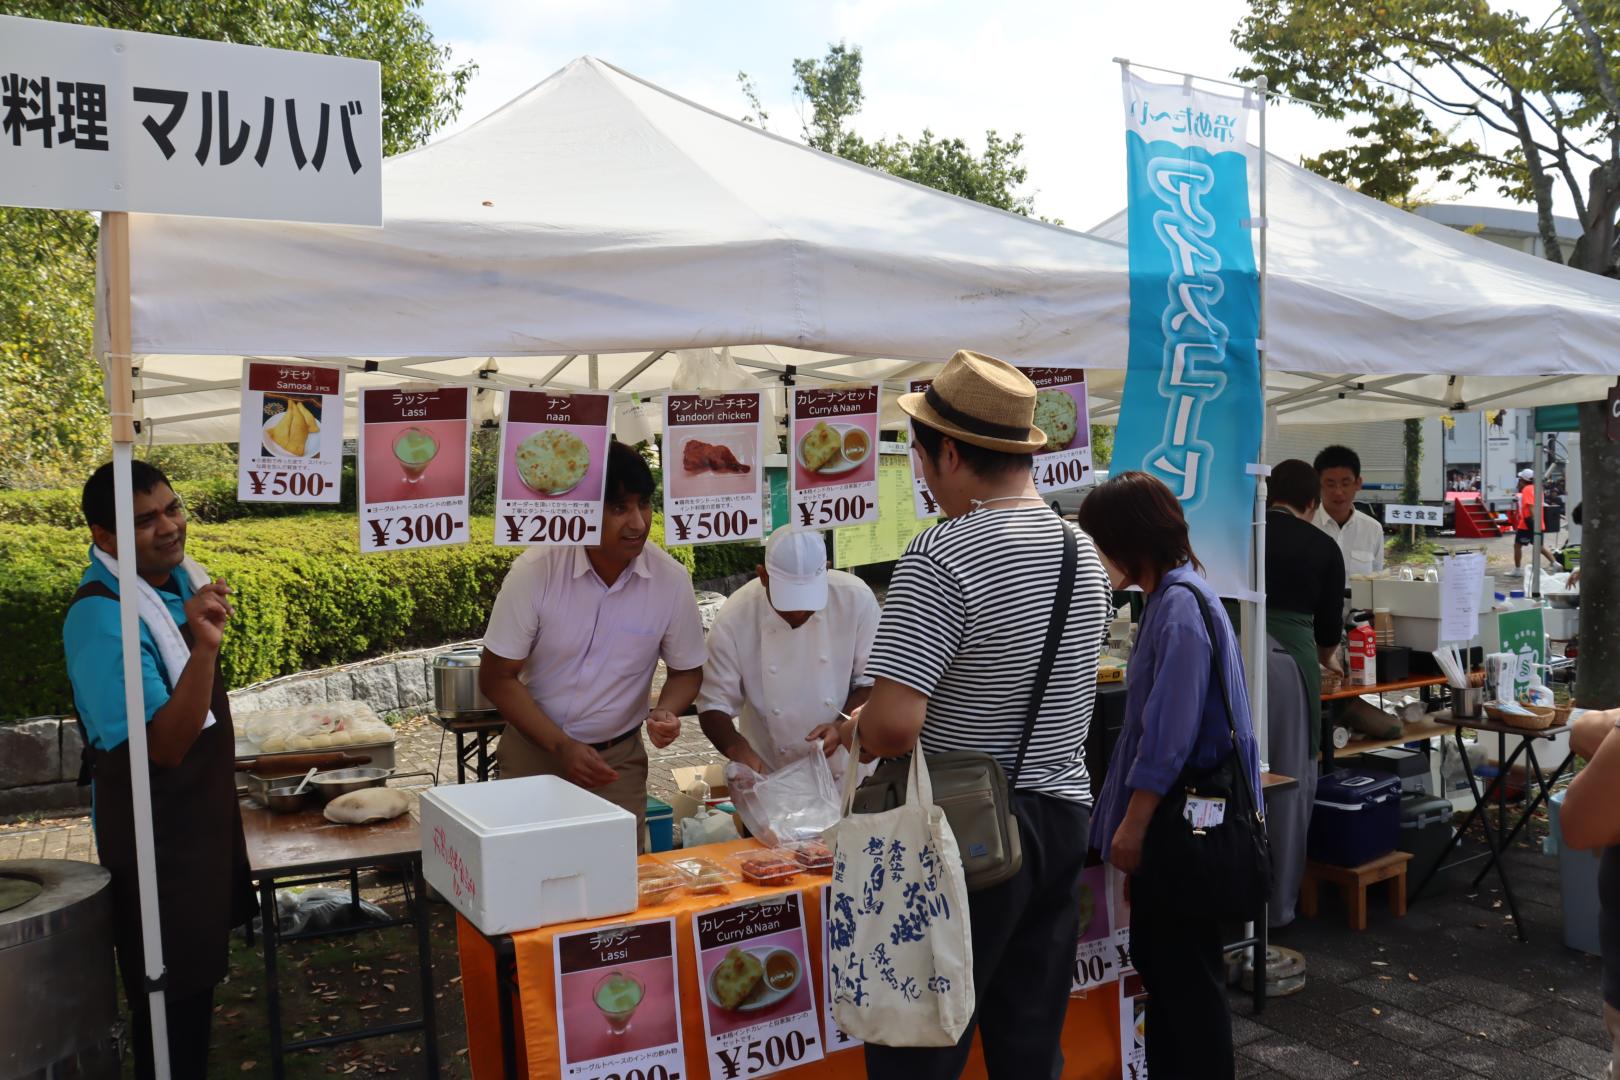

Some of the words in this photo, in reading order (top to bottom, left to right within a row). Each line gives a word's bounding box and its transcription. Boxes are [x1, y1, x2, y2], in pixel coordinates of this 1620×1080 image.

[1, 73, 109, 151] 料理
[133, 86, 363, 175] マルハバ
[278, 368, 312, 380] サモサ
[276, 381, 312, 391] Samosa
[1031, 377, 1052, 386] heese
[1054, 375, 1072, 383] Naan
[392, 393, 440, 406] ラッシー
[797, 390, 876, 405] カレーナンセット
[547, 398, 571, 410] ナン
[670, 398, 758, 411] タンドリーチキン
[401, 407, 427, 417] Lassi
[546, 413, 571, 422] naan
[676, 412, 714, 422] tandoori
[717, 411, 751, 420] chicken
[701, 900, 796, 933] カレーナンセット
[589, 933, 641, 950] ラッシー
[601, 948, 628, 962] Lassi
